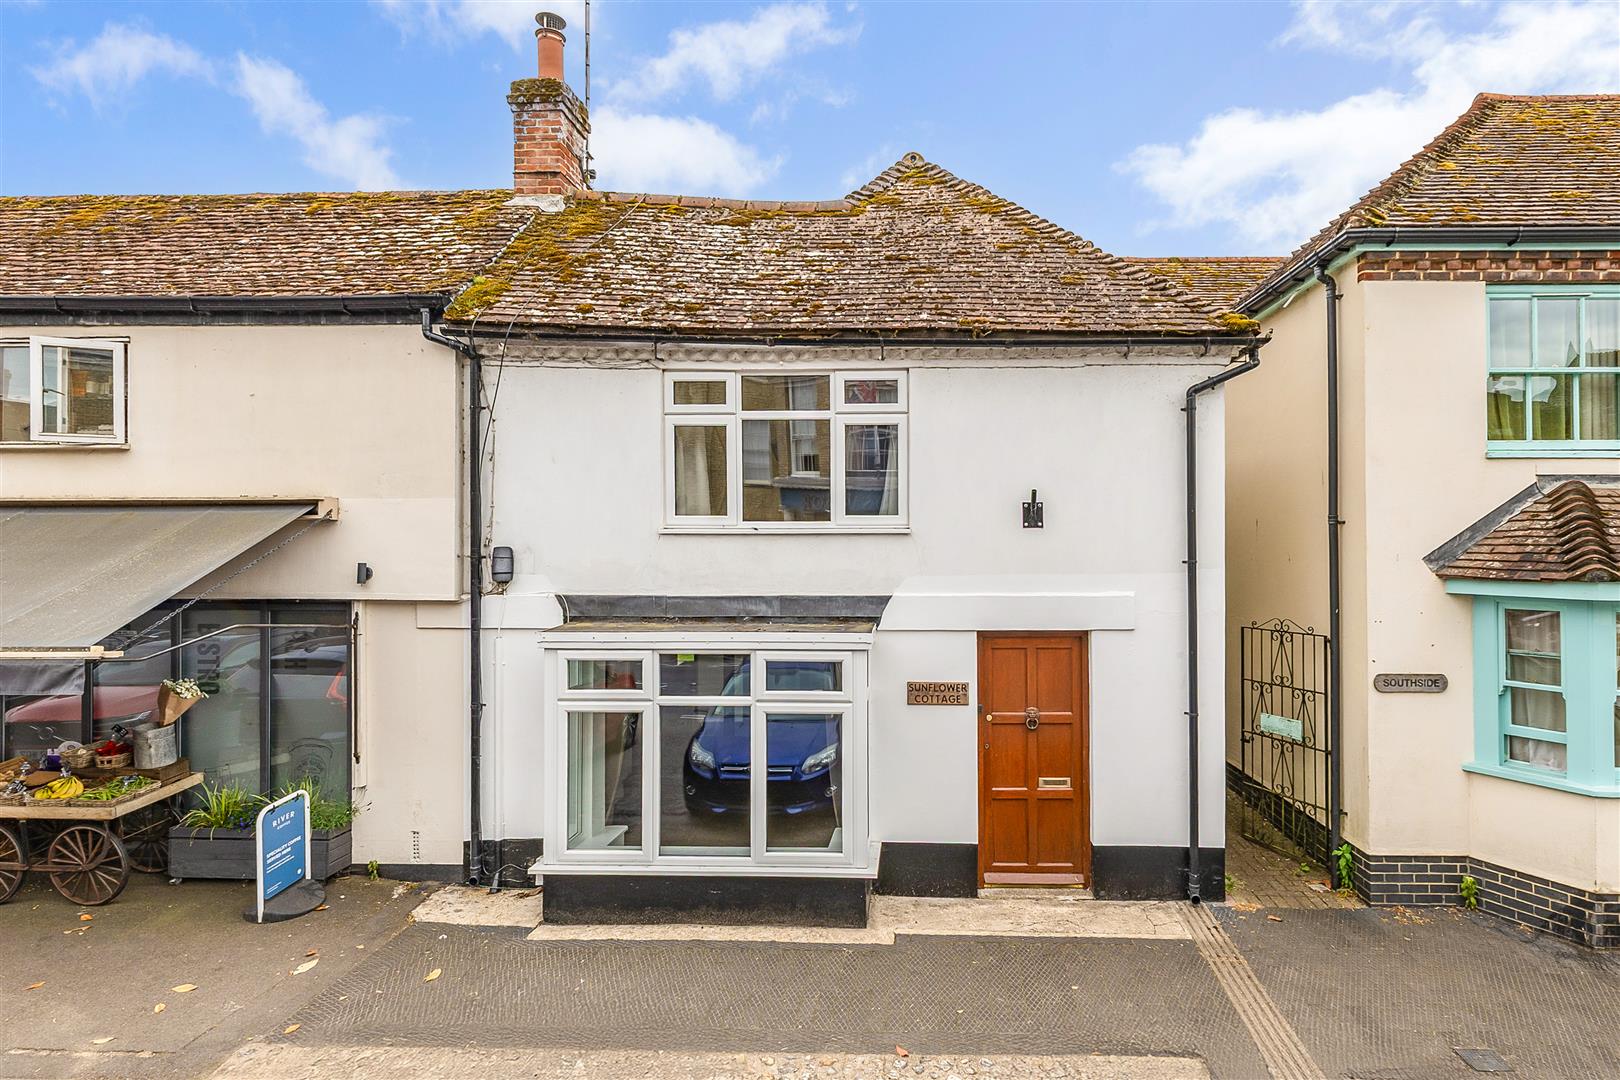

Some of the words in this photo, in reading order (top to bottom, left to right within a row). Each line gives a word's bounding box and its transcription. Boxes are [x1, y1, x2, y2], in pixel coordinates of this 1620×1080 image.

[197, 623, 221, 695] BSTRO
[908, 683, 968, 693] SUNFLOWER
[1383, 678, 1441, 688] SOUTHSIDE
[914, 694, 962, 704] COTTAGE
[272, 810, 296, 828] RIVER
[287, 835, 302, 847] COFFEE
